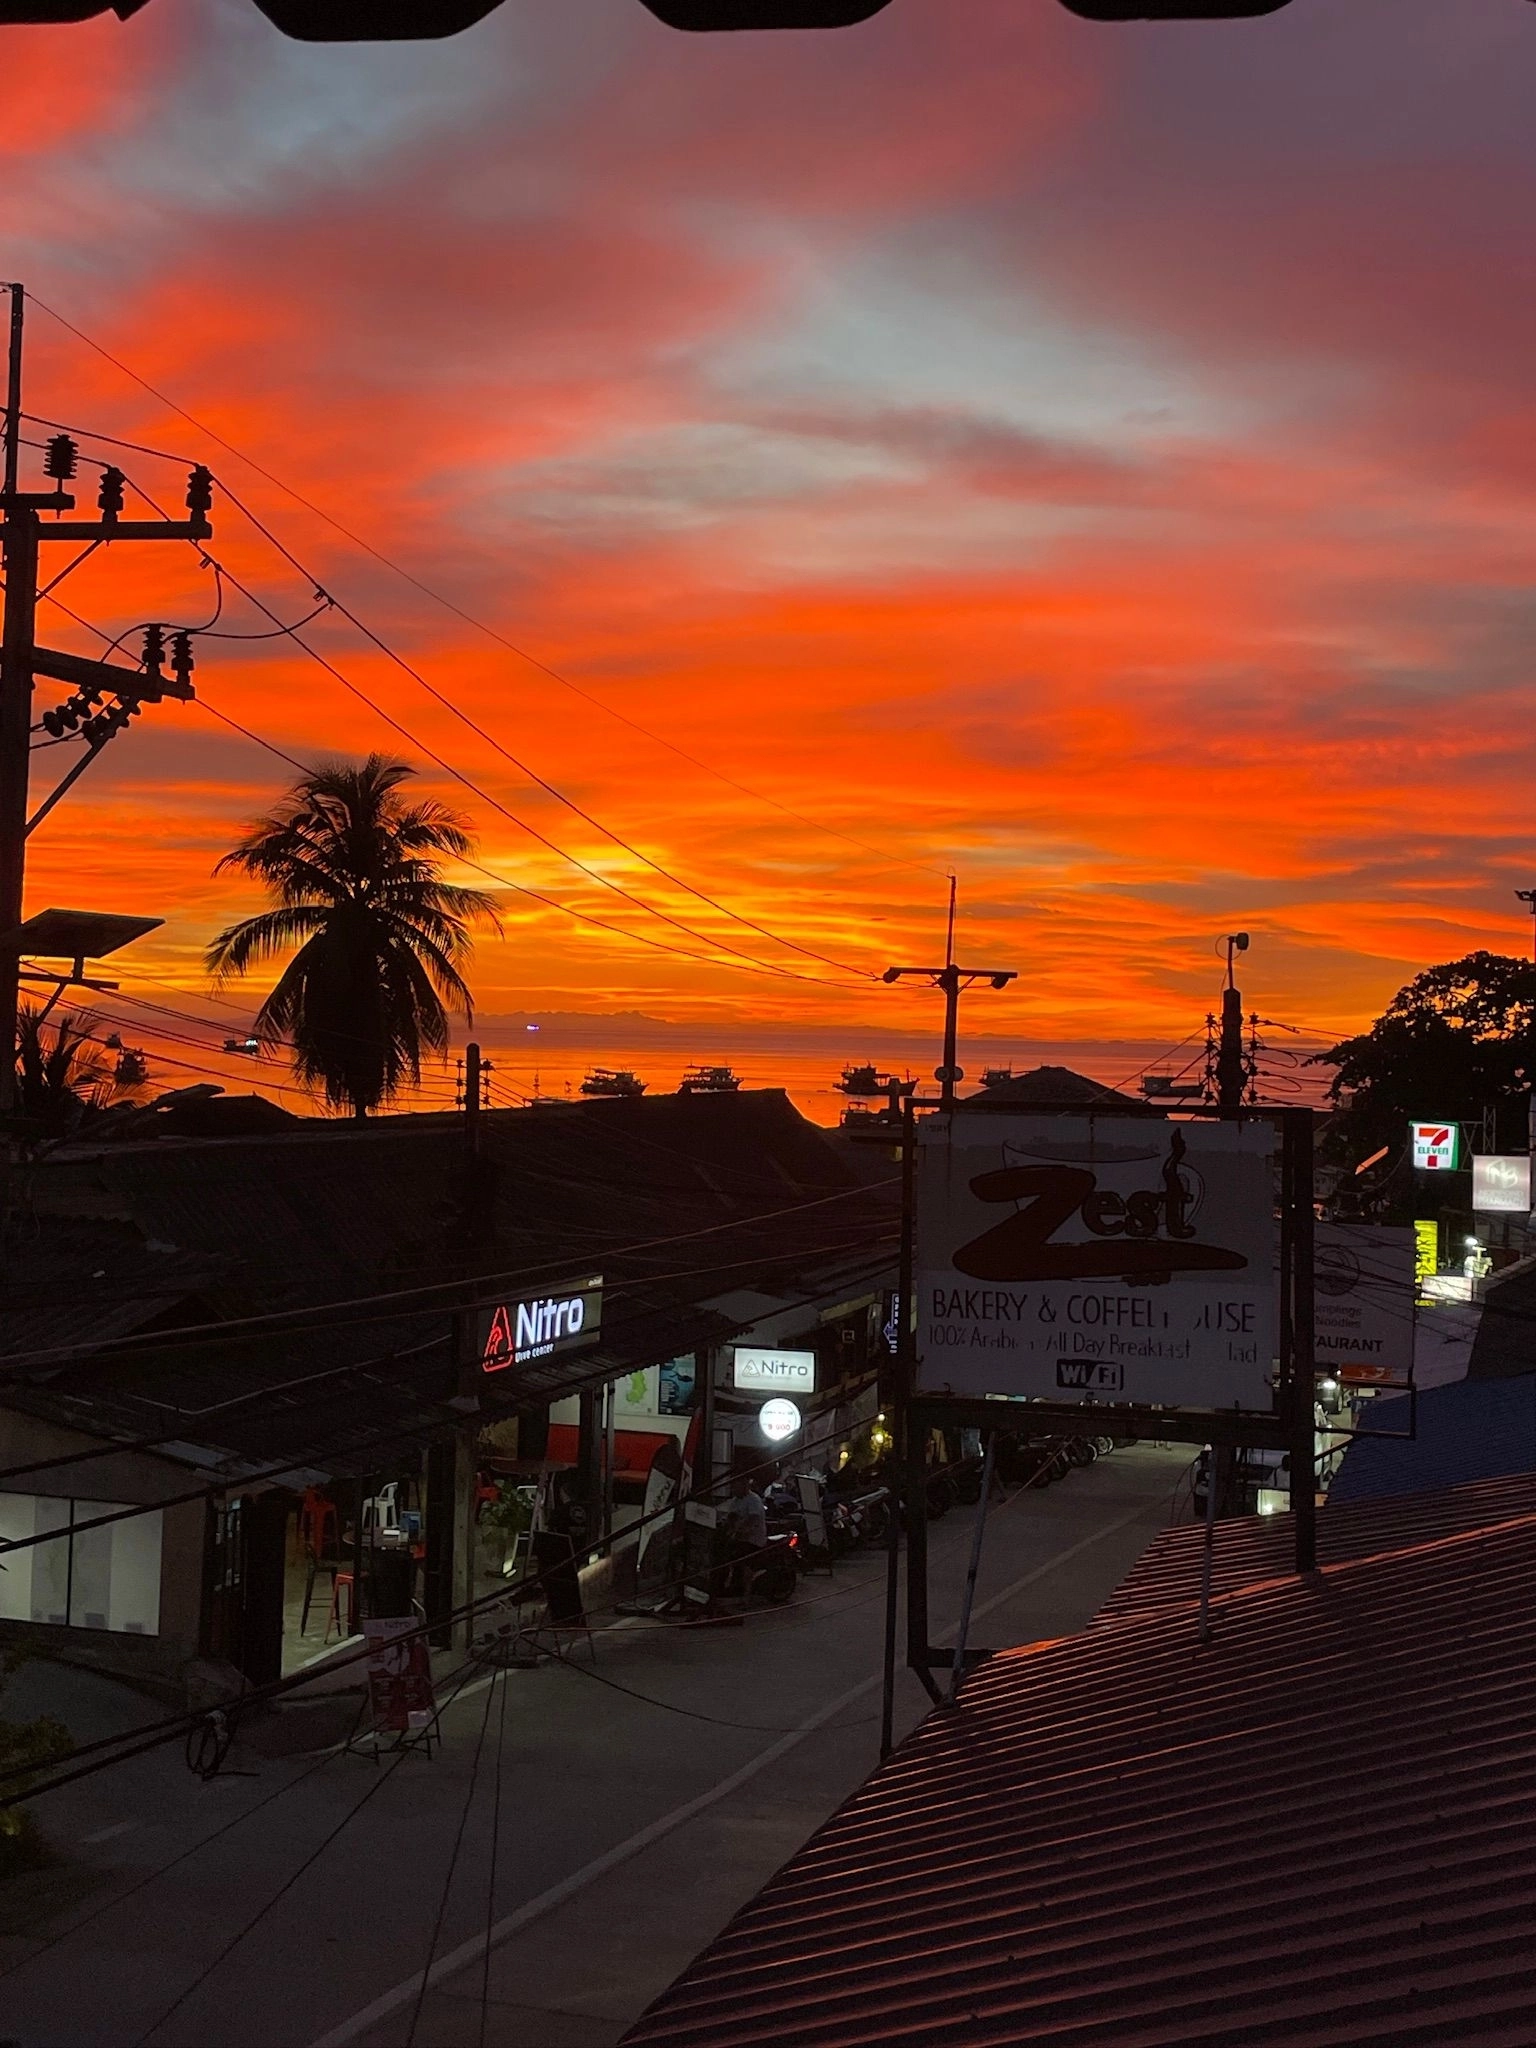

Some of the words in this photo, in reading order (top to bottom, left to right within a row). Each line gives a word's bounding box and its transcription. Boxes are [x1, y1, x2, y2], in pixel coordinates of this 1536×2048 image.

[1418, 1127, 1449, 1167] 7
[953, 1128, 1248, 1281] Zest
[515, 1297, 585, 1349] Nitro
[933, 1289, 1028, 1320] BAKERY
[1038, 1294, 1057, 1322] &
[929, 1324, 967, 1346] 100%
[1073, 1331, 1105, 1358] Day
[761, 1360, 808, 1376] Nitro
